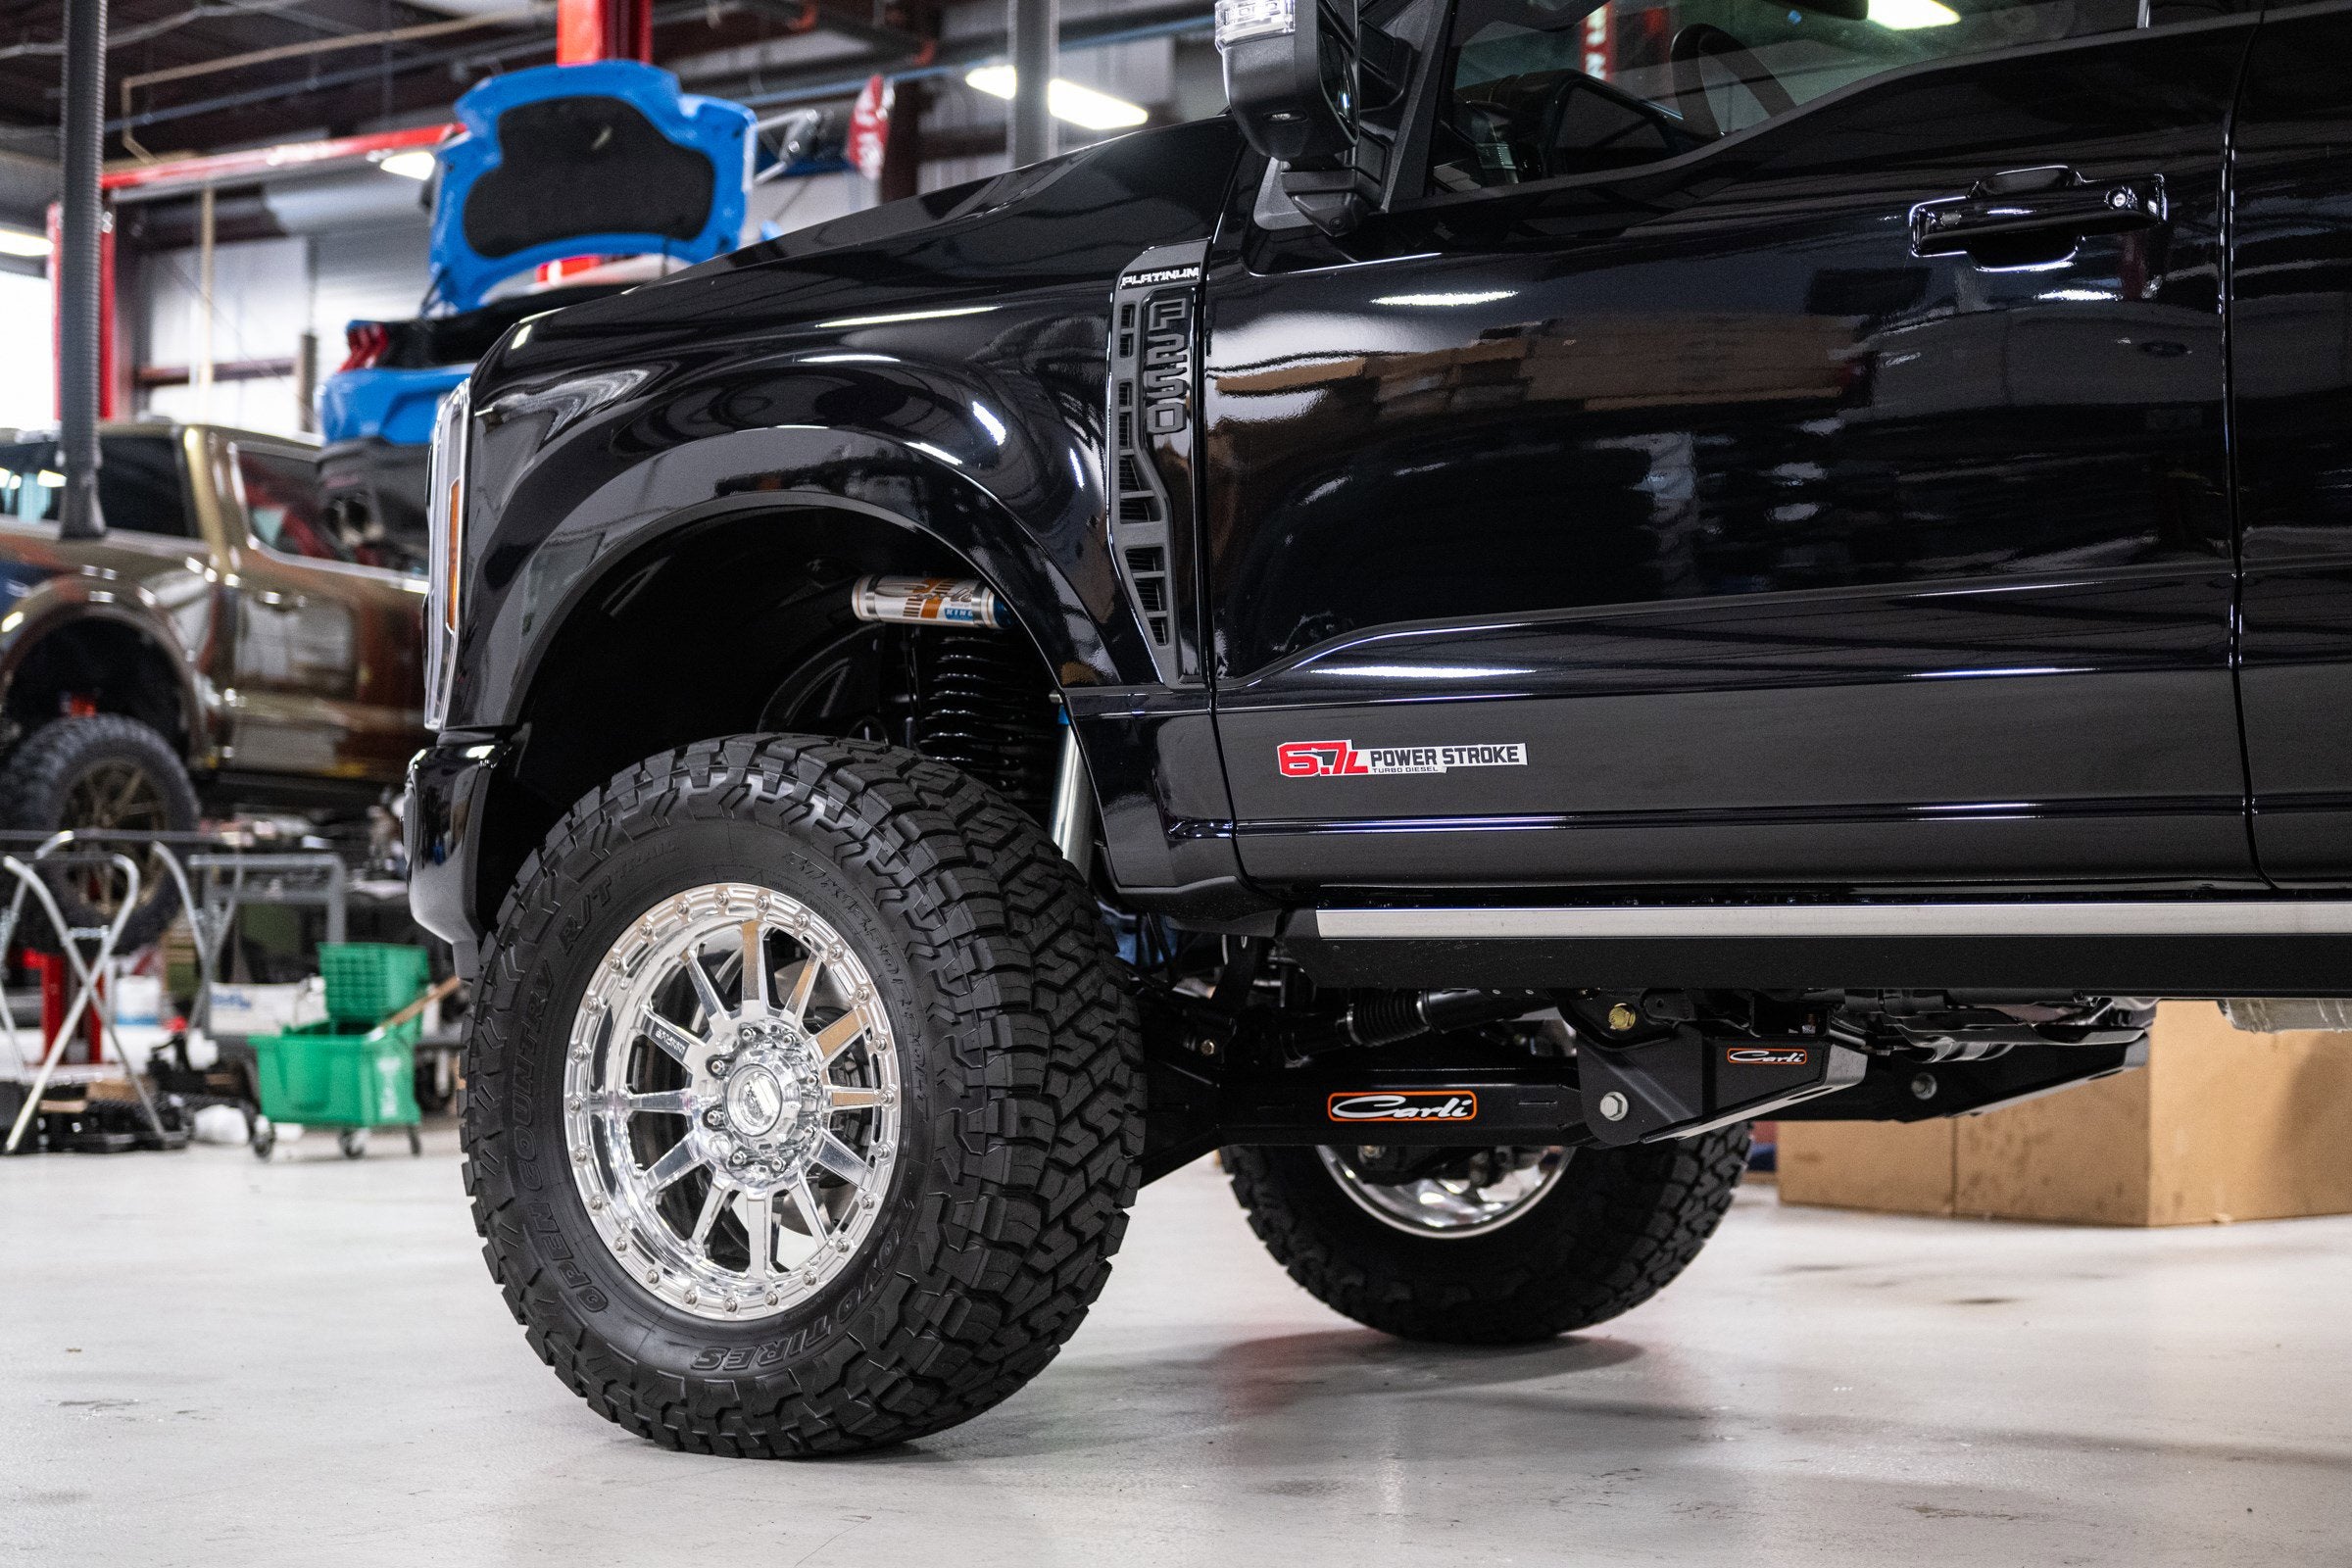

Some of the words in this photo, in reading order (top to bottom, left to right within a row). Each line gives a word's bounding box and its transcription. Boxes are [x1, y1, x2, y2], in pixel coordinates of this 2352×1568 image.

[1119, 267, 1200, 289] PLATINUM
[1146, 297, 1188, 435] F250
[1278, 741, 1369, 776] 6.7L
[1371, 748, 1438, 767] POWER
[1442, 745, 1519, 765] STROKE
[557, 875, 613, 956] R/T
[512, 956, 555, 1192] COUNTRY
[1730, 1050, 1805, 1063] Carli
[1331, 1094, 1473, 1119] Carli
[529, 1201, 609, 1313] OPEN
[690, 1315, 831, 1370] TIRES
